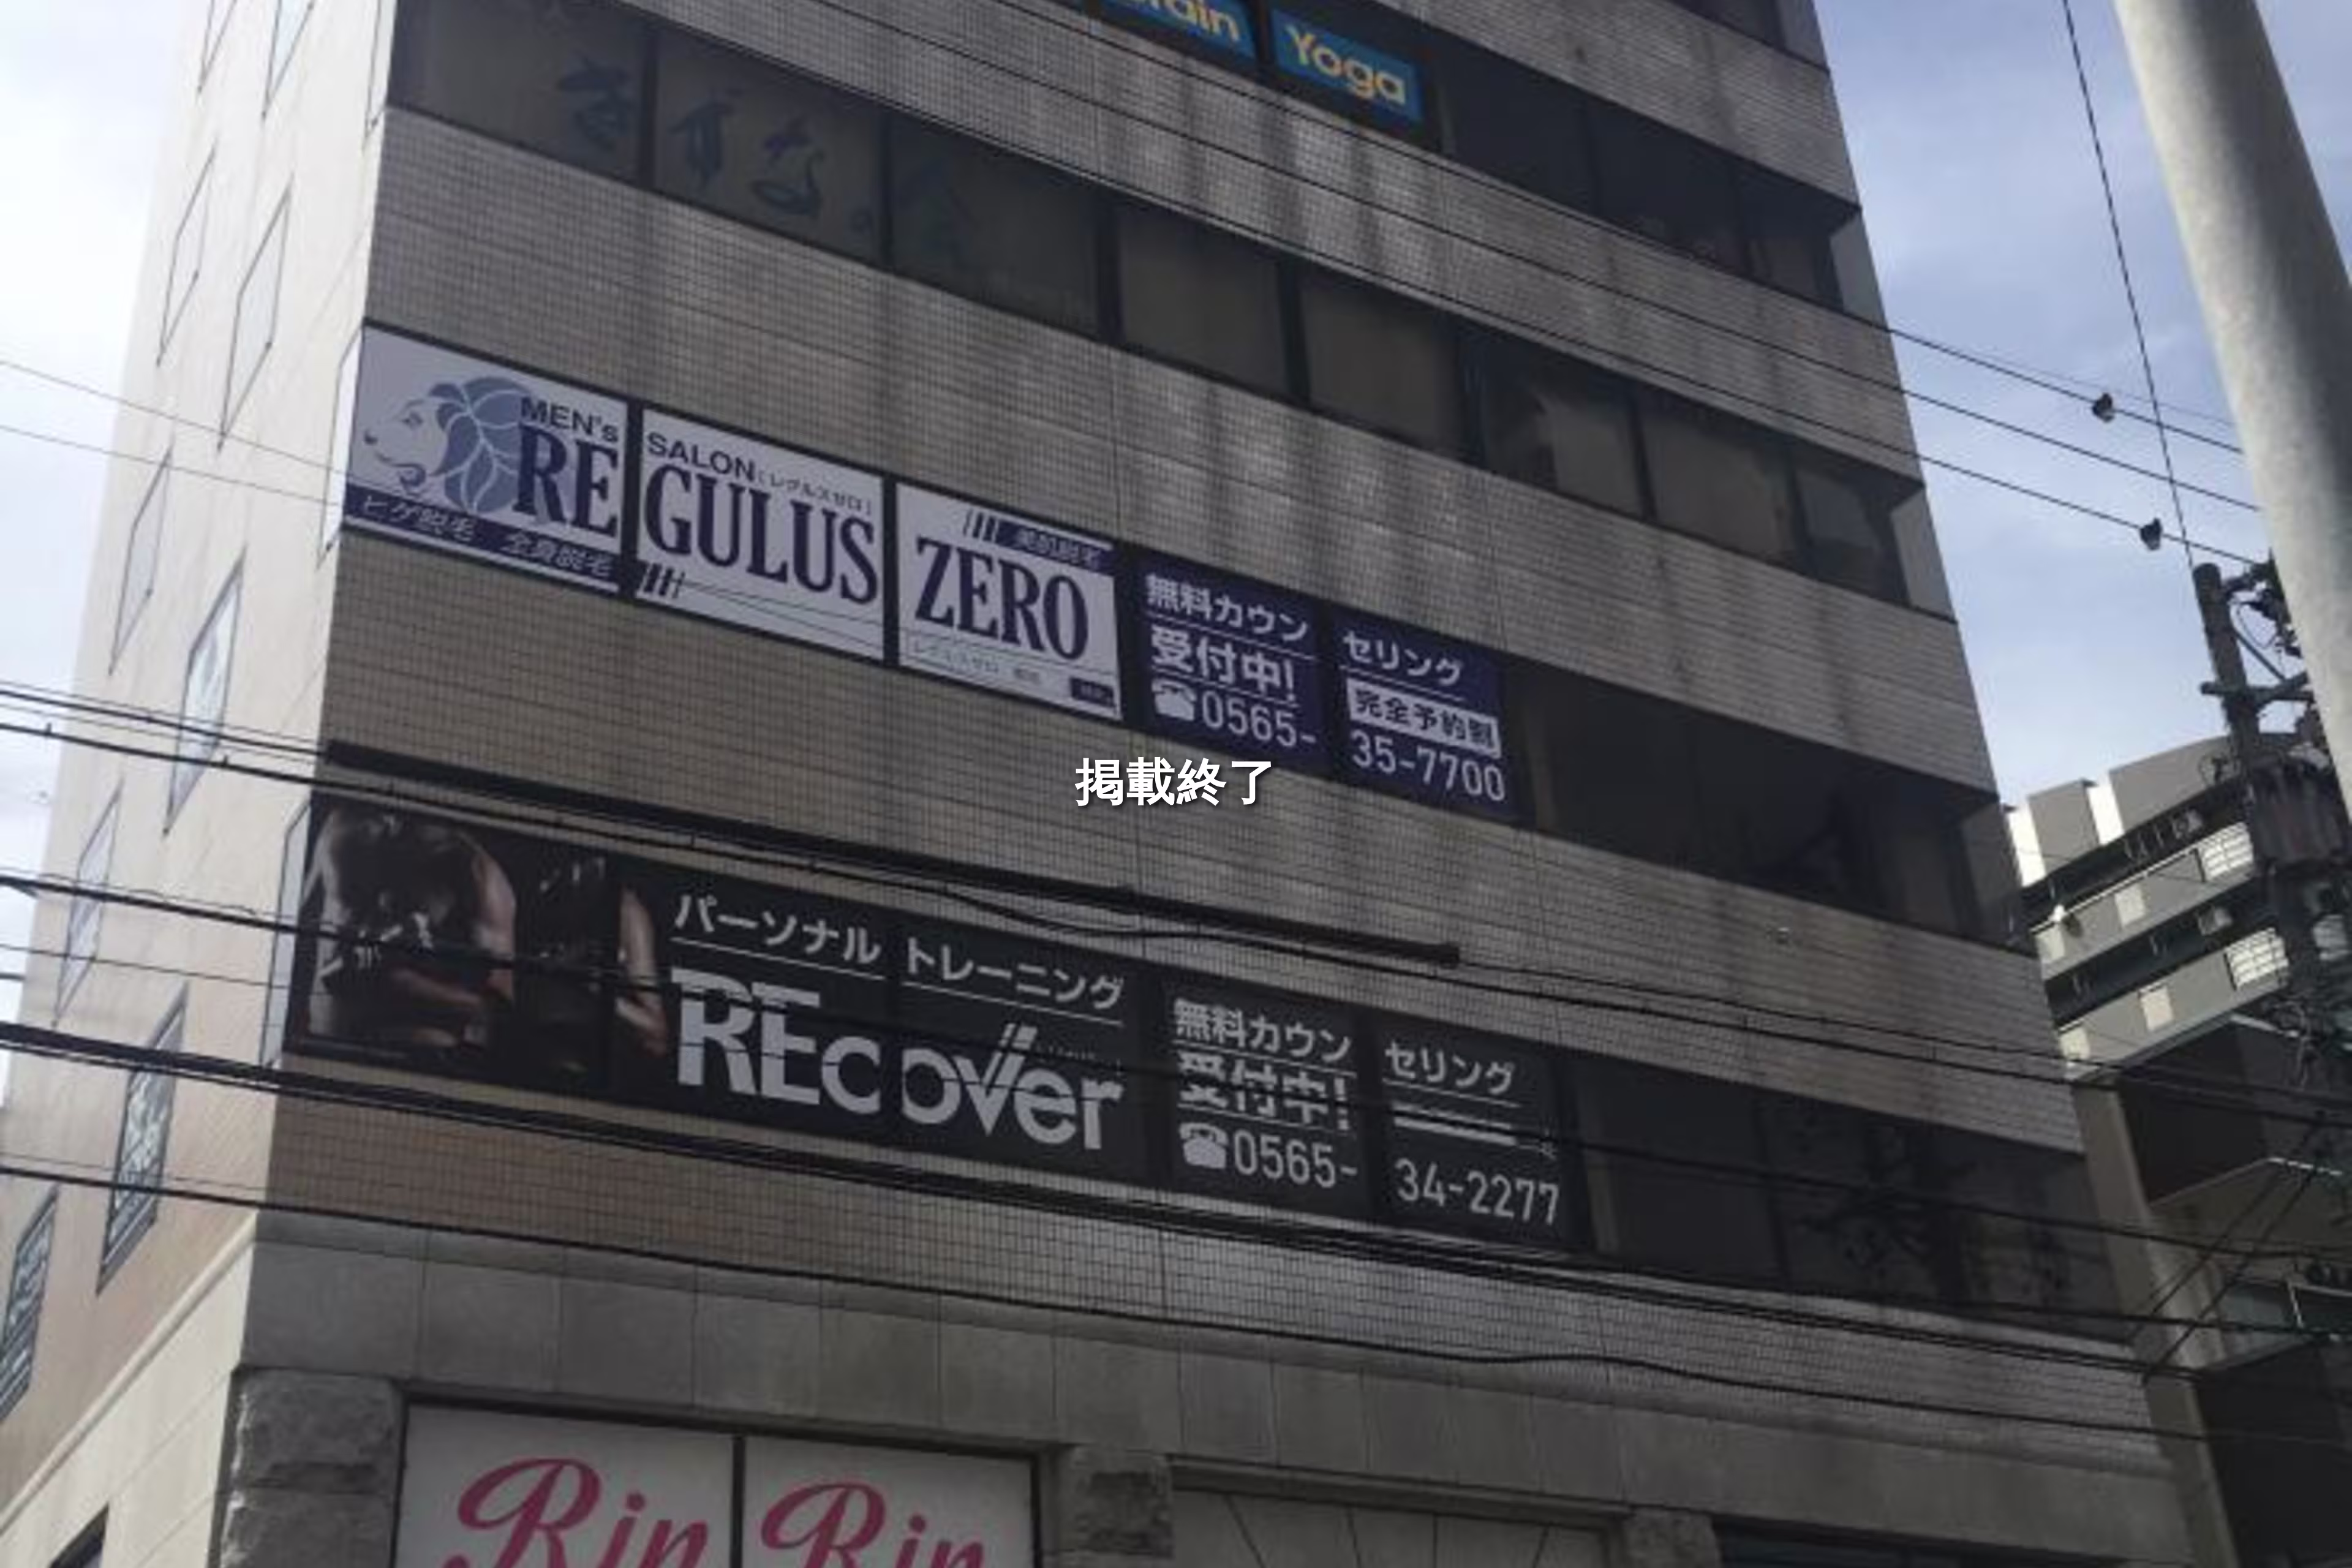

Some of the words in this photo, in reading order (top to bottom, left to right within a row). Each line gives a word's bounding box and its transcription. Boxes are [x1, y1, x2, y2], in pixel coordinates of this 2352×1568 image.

[1287, 26, 1406, 105] Yoga
[521, 397, 618, 443] MEN's
[647, 432, 755, 482] SALON
[915, 537, 1088, 660] ZERO
[1351, 730, 1506, 801] 35-7700
[674, 894, 882, 967] パーソナル
[906, 937, 1125, 1010] トレーニング
[1395, 1158, 1560, 1225] 34-2277
